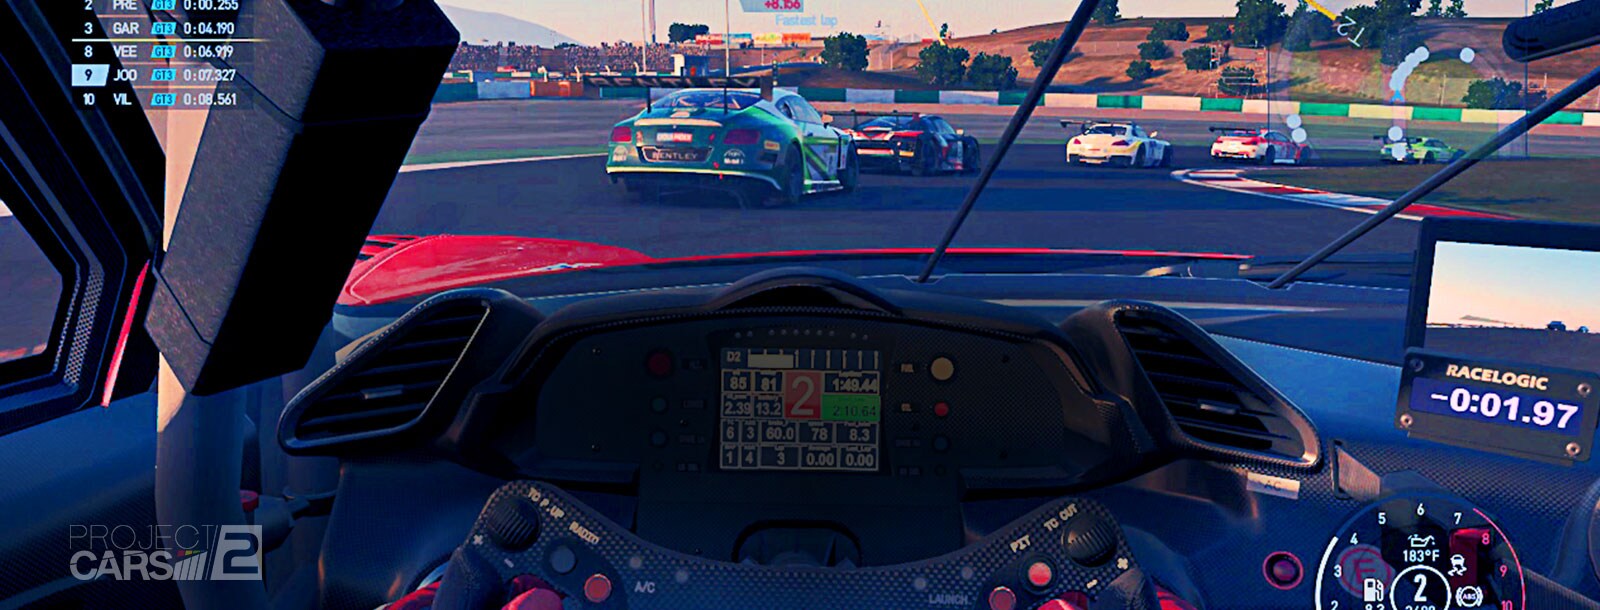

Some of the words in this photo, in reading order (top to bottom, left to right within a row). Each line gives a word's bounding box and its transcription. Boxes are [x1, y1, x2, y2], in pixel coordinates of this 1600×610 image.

[652, 151, 698, 160] BENTLEY
[727, 351, 741, 362] D2
[730, 377, 747, 390] 85
[761, 377, 776, 391] 81
[1446, 364, 1548, 391] RACELOGIC
[832, 378, 878, 392] 1:49.44
[790, 375, 815, 416] 2
[725, 402, 751, 415] 2.39
[756, 402, 781, 415] 13.2
[1431, 388, 1579, 429] -0:01.97
[726, 427, 735, 439] 6
[746, 427, 755, 439] 3
[766, 427, 794, 440] 60.0
[811, 427, 828, 440] 78
[850, 428, 870, 441] 8.3
[726, 451, 733, 464] 1
[745, 451, 753, 464] 4
[777, 452, 785, 465] 3
[806, 453, 834, 466] 0.00
[846, 453, 874, 466] 0.00
[569, 521, 600, 545] RADIO
[1009, 534, 1031, 553] PIT
[634, 581, 656, 594] A/C
